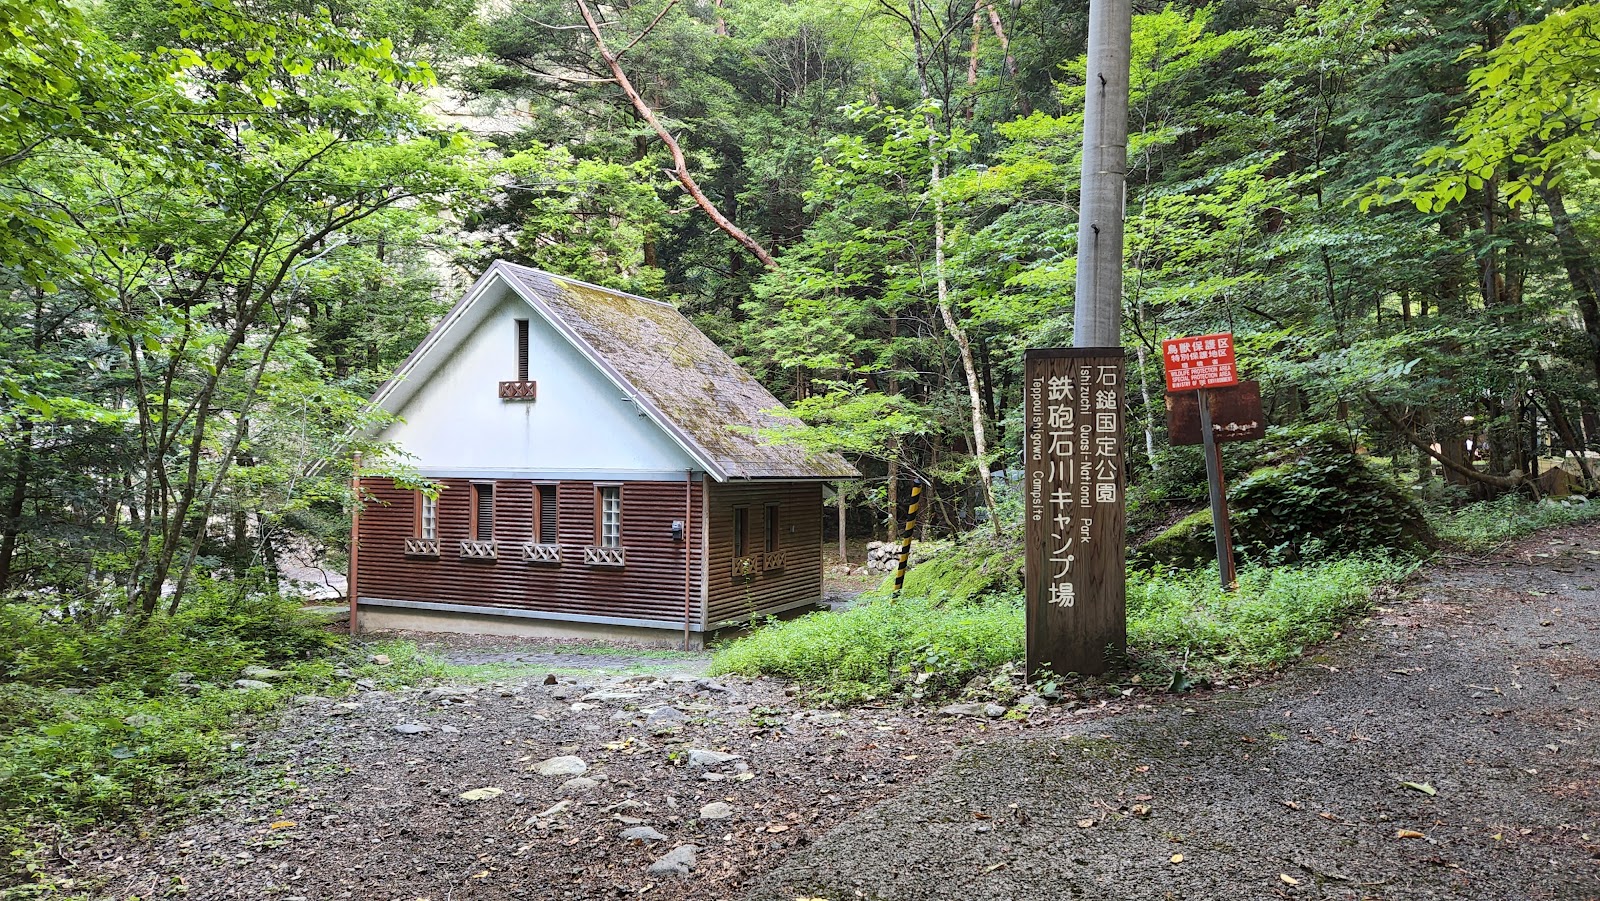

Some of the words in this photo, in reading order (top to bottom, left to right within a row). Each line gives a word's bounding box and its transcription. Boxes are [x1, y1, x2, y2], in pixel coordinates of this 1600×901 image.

[1167, 338, 1229, 355] 鳥獣保護区
[1170, 348, 1227, 362] 特別保護地区
[1191, 366, 1218, 375] PROTECTION
[1080, 365, 1092, 415] Ishizuchi
[1172, 375, 1190, 383] SPECIAL
[1191, 372, 1218, 381] PROTECTION
[1219, 370, 1232, 378] AREA
[1030, 376, 1044, 460] Teppouishigawa
[1095, 365, 1117, 503] 石鎚国定公園
[1080, 424, 1092, 508] Quasi-National
[1030, 470, 1044, 521] Campsite
[1047, 375, 1075, 608] 鉄砲石川キャンプ場
[1080, 518, 1092, 543] Park
